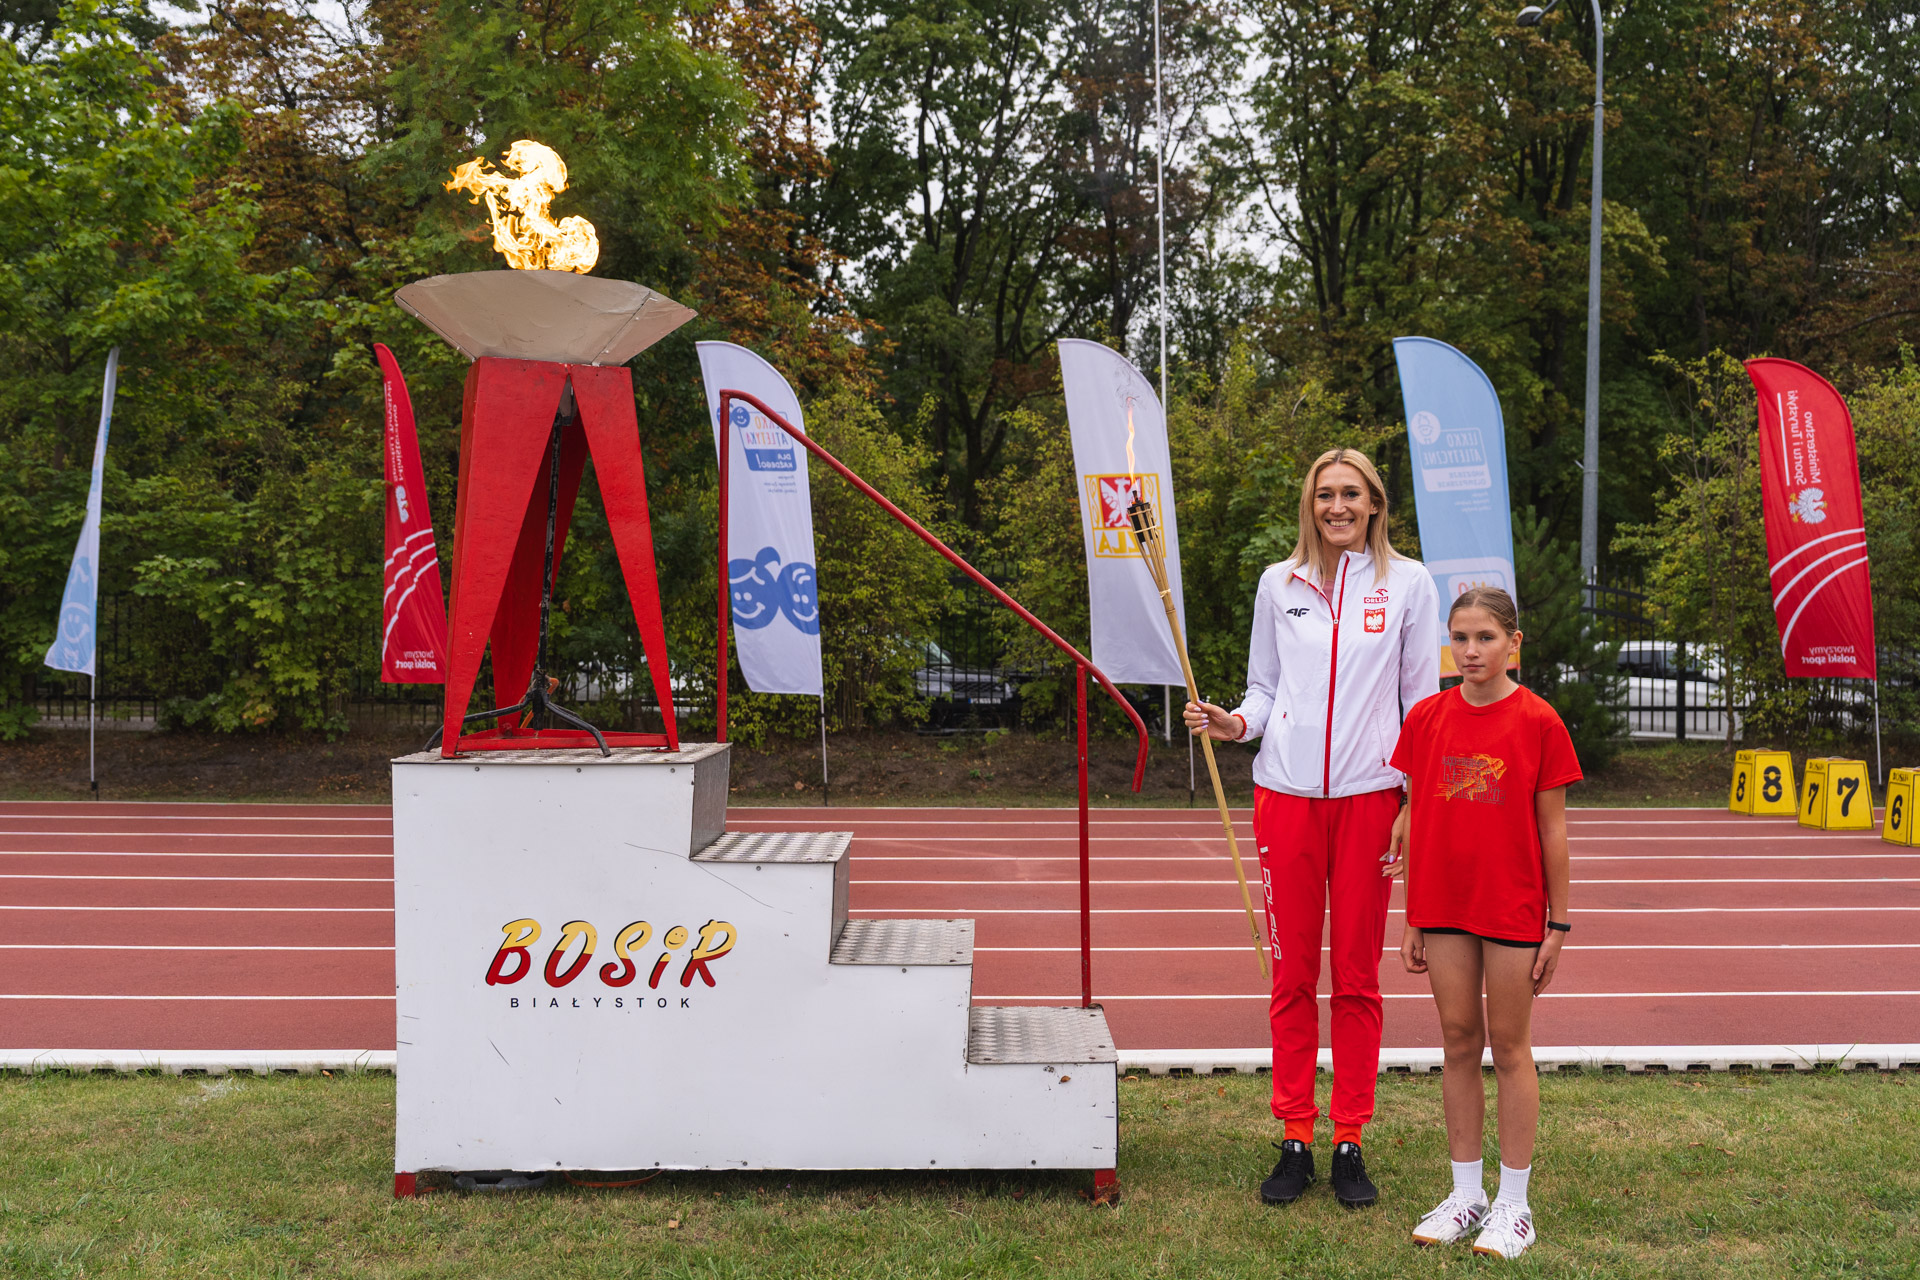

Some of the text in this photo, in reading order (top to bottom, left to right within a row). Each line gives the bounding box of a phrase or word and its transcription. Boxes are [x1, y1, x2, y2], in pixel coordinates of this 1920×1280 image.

[1286, 608, 1310, 617] 4F
[1736, 772, 1746, 802] 8
[1762, 765, 1782, 802] 8
[1808, 782, 1819, 815] 7
[1837, 777, 1860, 817] 7
[1891, 794, 1903, 830] 6
[510, 997, 690, 1009] BIAŁYSTOK
